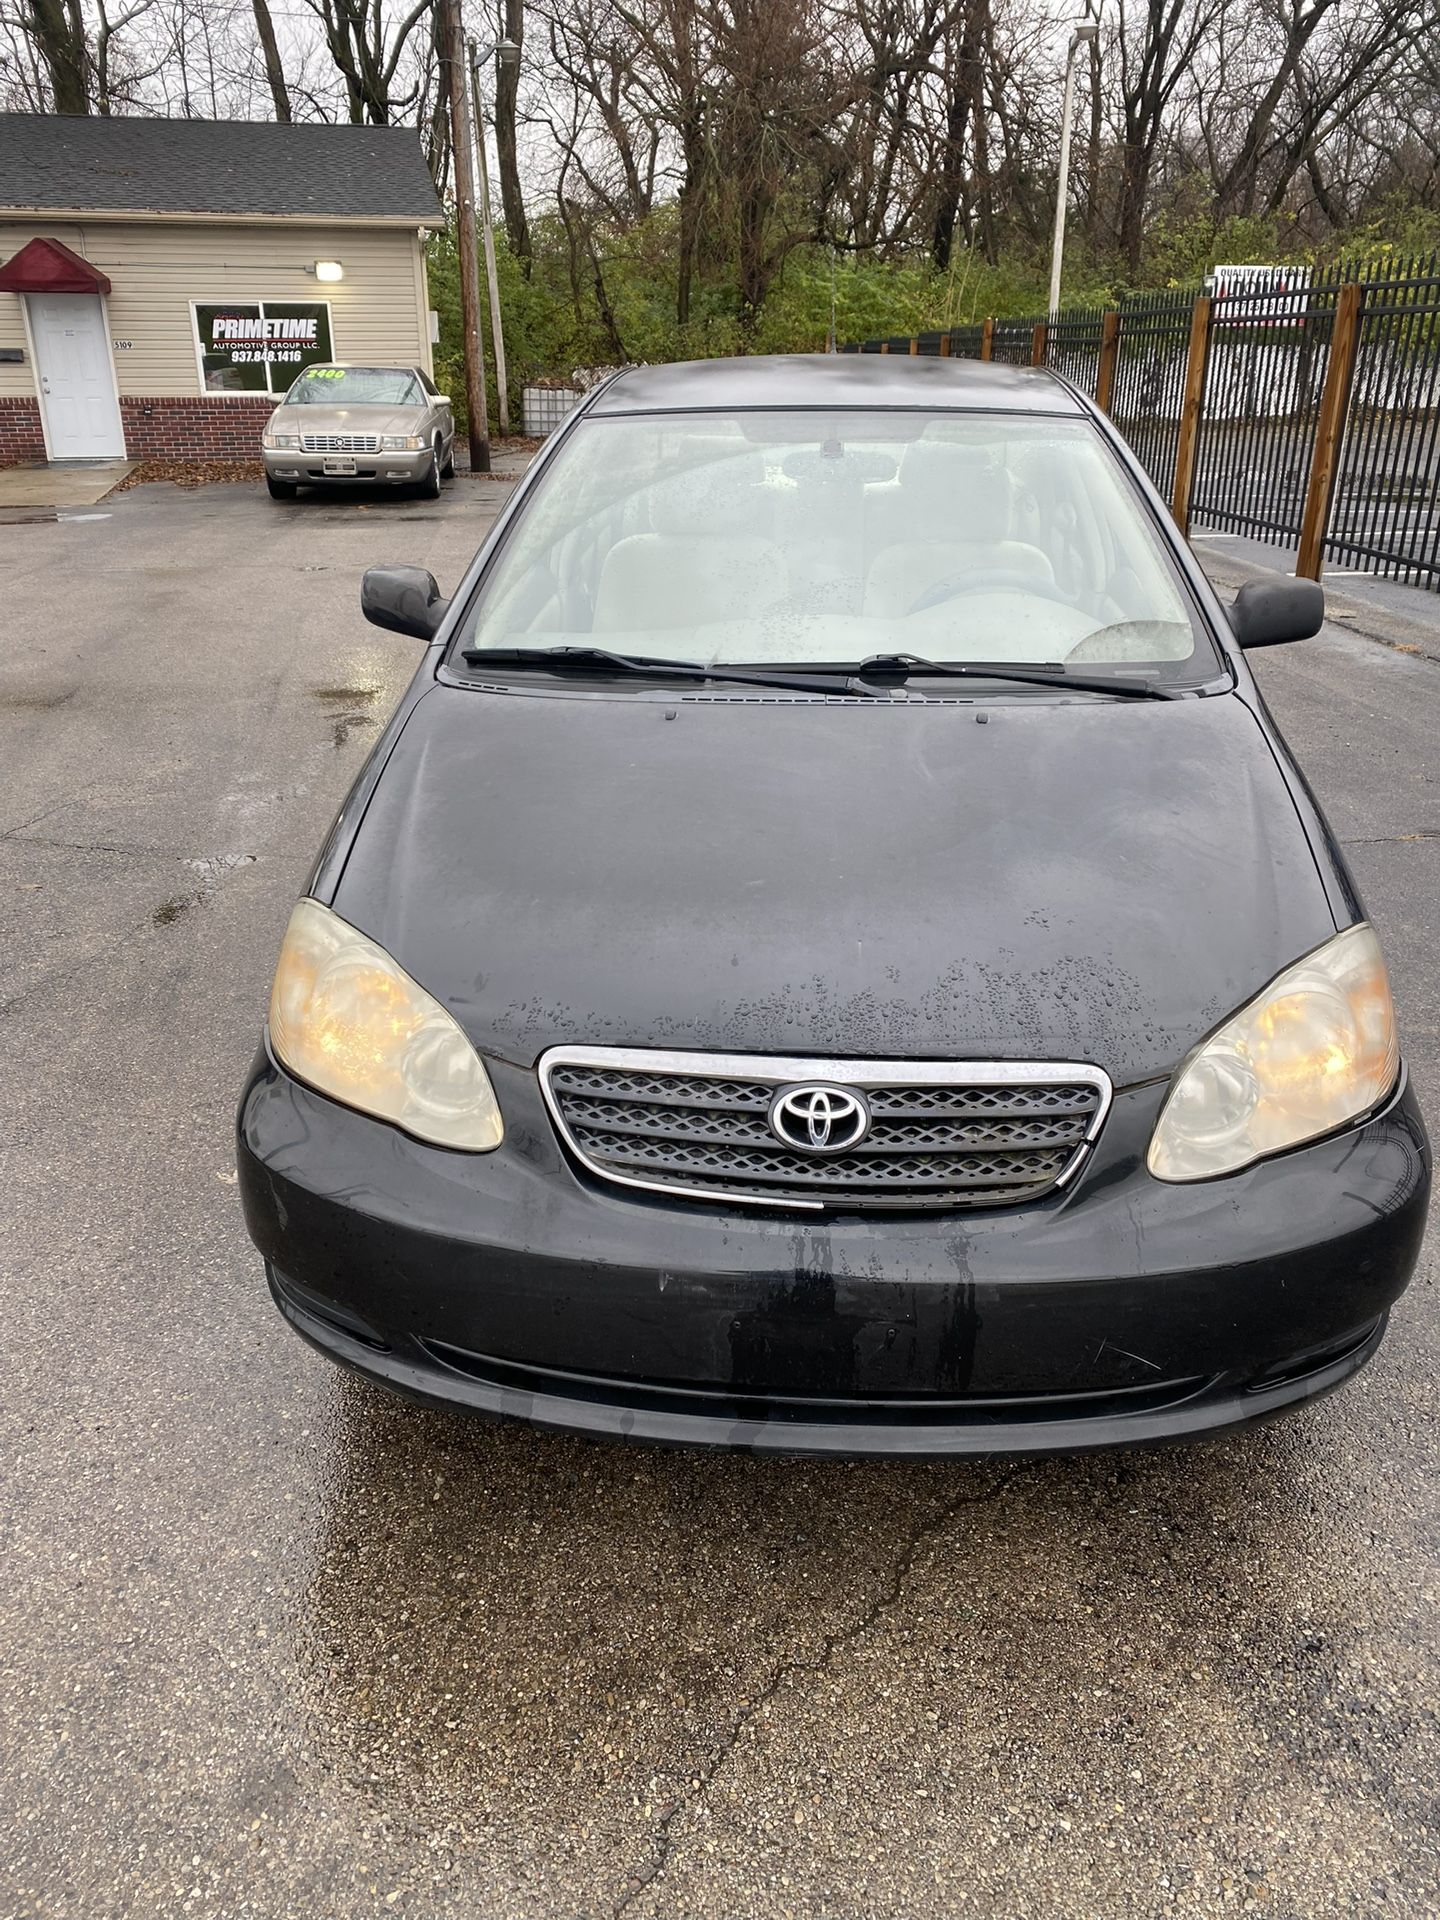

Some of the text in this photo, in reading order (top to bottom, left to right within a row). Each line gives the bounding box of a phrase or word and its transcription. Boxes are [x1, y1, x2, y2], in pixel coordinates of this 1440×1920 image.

[1220, 268, 1256, 277] QUALITY
[1259, 268, 1282, 277] USD
[212, 318, 318, 339] PRIMETIME
[114, 341, 132, 349] 5109
[212, 341, 320, 350] AUTOMOTIVE GROUP LLC.
[231, 350, 302, 363] 937.848.1416
[305, 369, 346, 379] 2400
